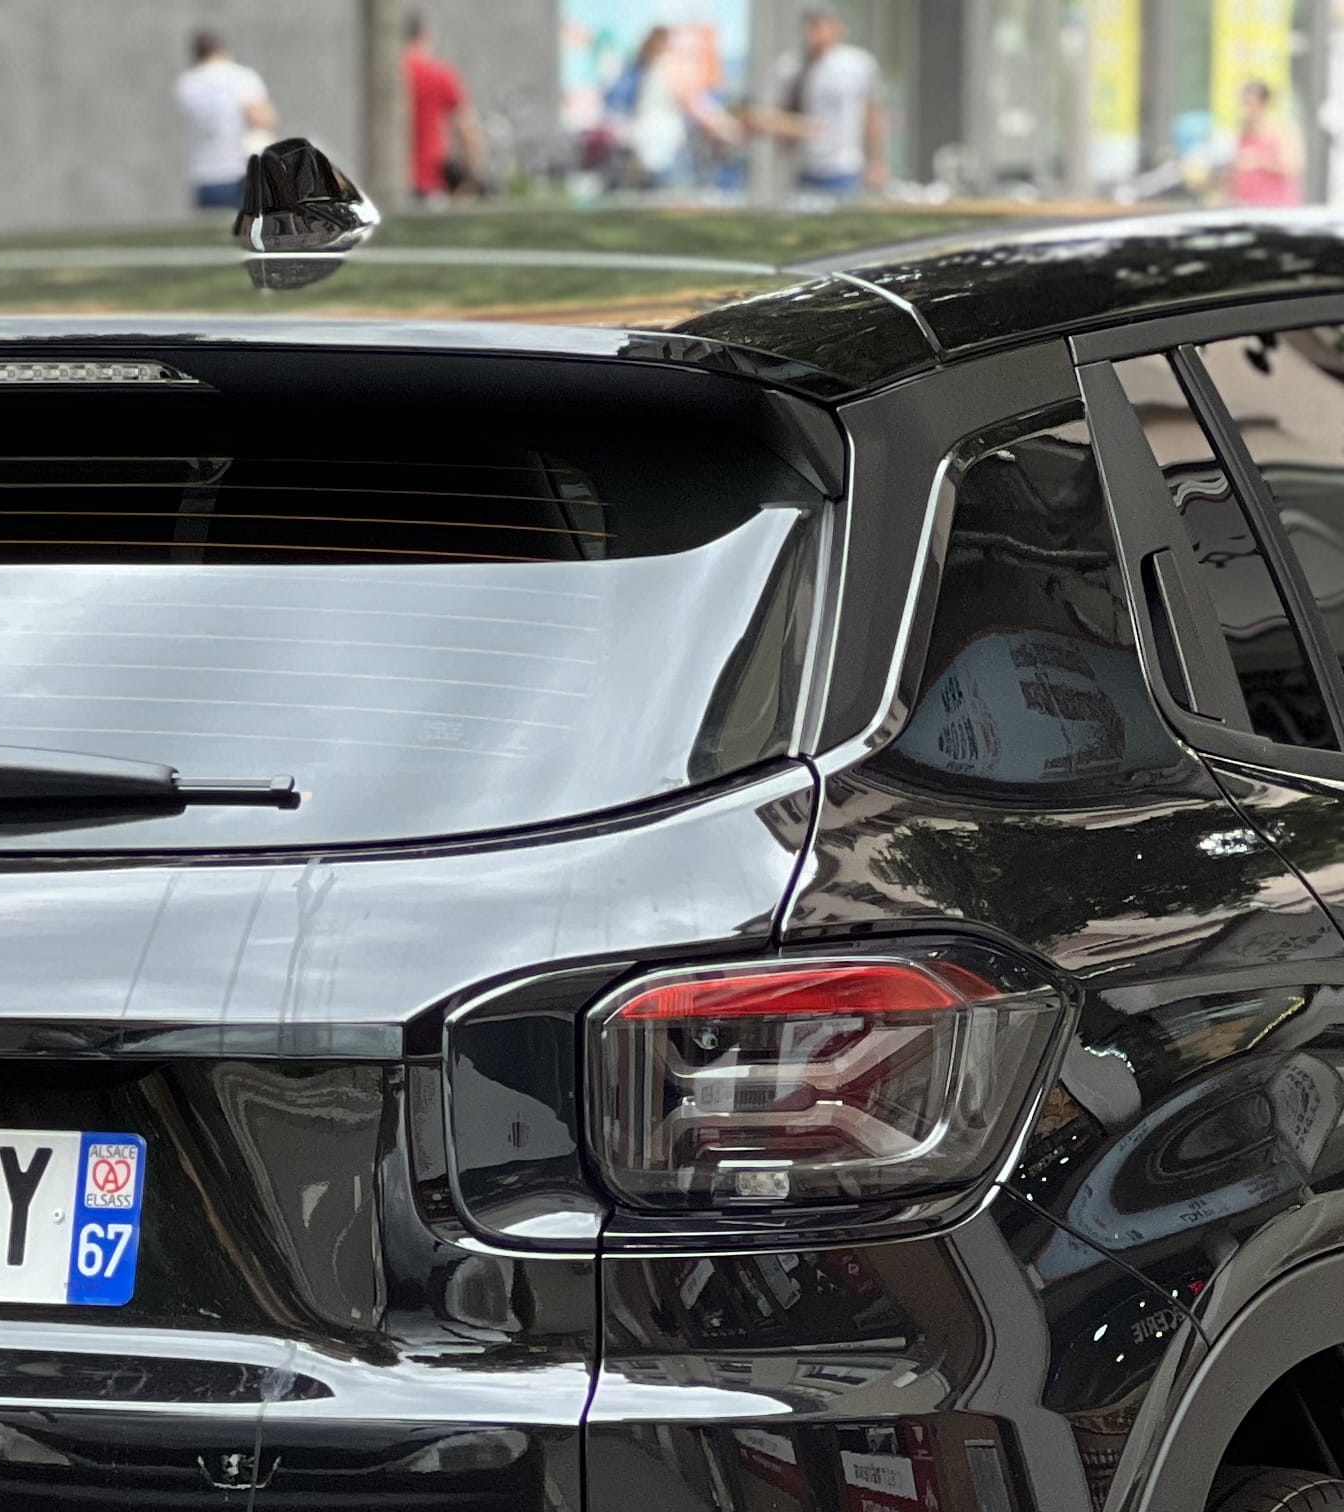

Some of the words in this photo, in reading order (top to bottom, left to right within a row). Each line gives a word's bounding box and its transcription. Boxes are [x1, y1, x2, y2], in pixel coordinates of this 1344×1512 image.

[89, 1144, 136, 1160] ALSACE
[86, 1193, 132, 1207] ELSASS
[77, 1222, 133, 1278] 67
